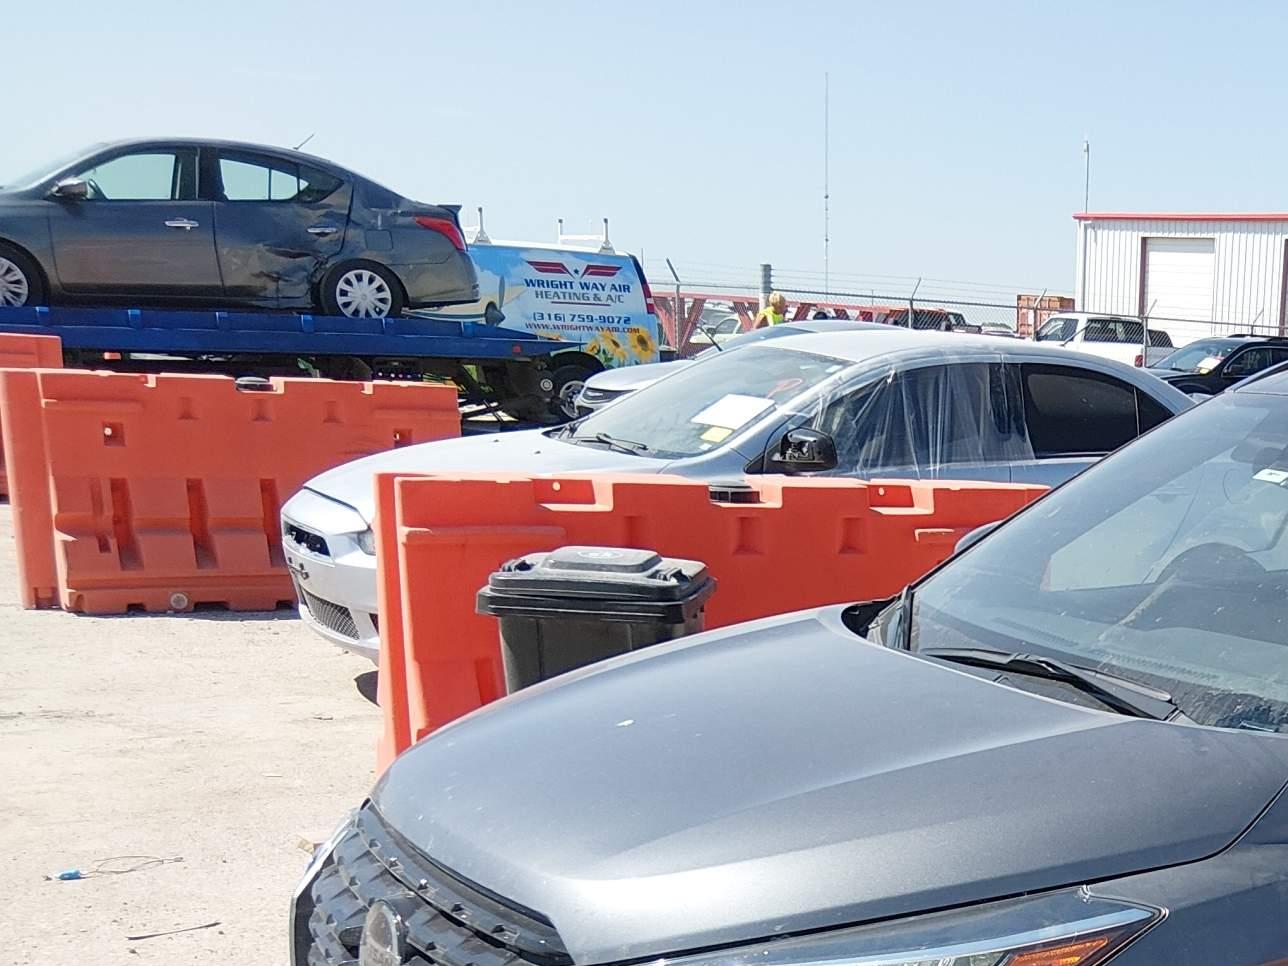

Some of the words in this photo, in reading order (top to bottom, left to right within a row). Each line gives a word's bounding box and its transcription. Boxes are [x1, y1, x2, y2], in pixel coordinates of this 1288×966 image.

[524, 279, 574, 290] WRIGHT
[579, 281, 609, 291] WAY
[609, 284, 631, 293] AIR
[535, 290, 590, 301] HEATING
[593, 293, 602, 302] &
[605, 294, 624, 303] A/C
[533, 312, 566, 323] (316)
[569, 314, 631, 325] 759-9072
